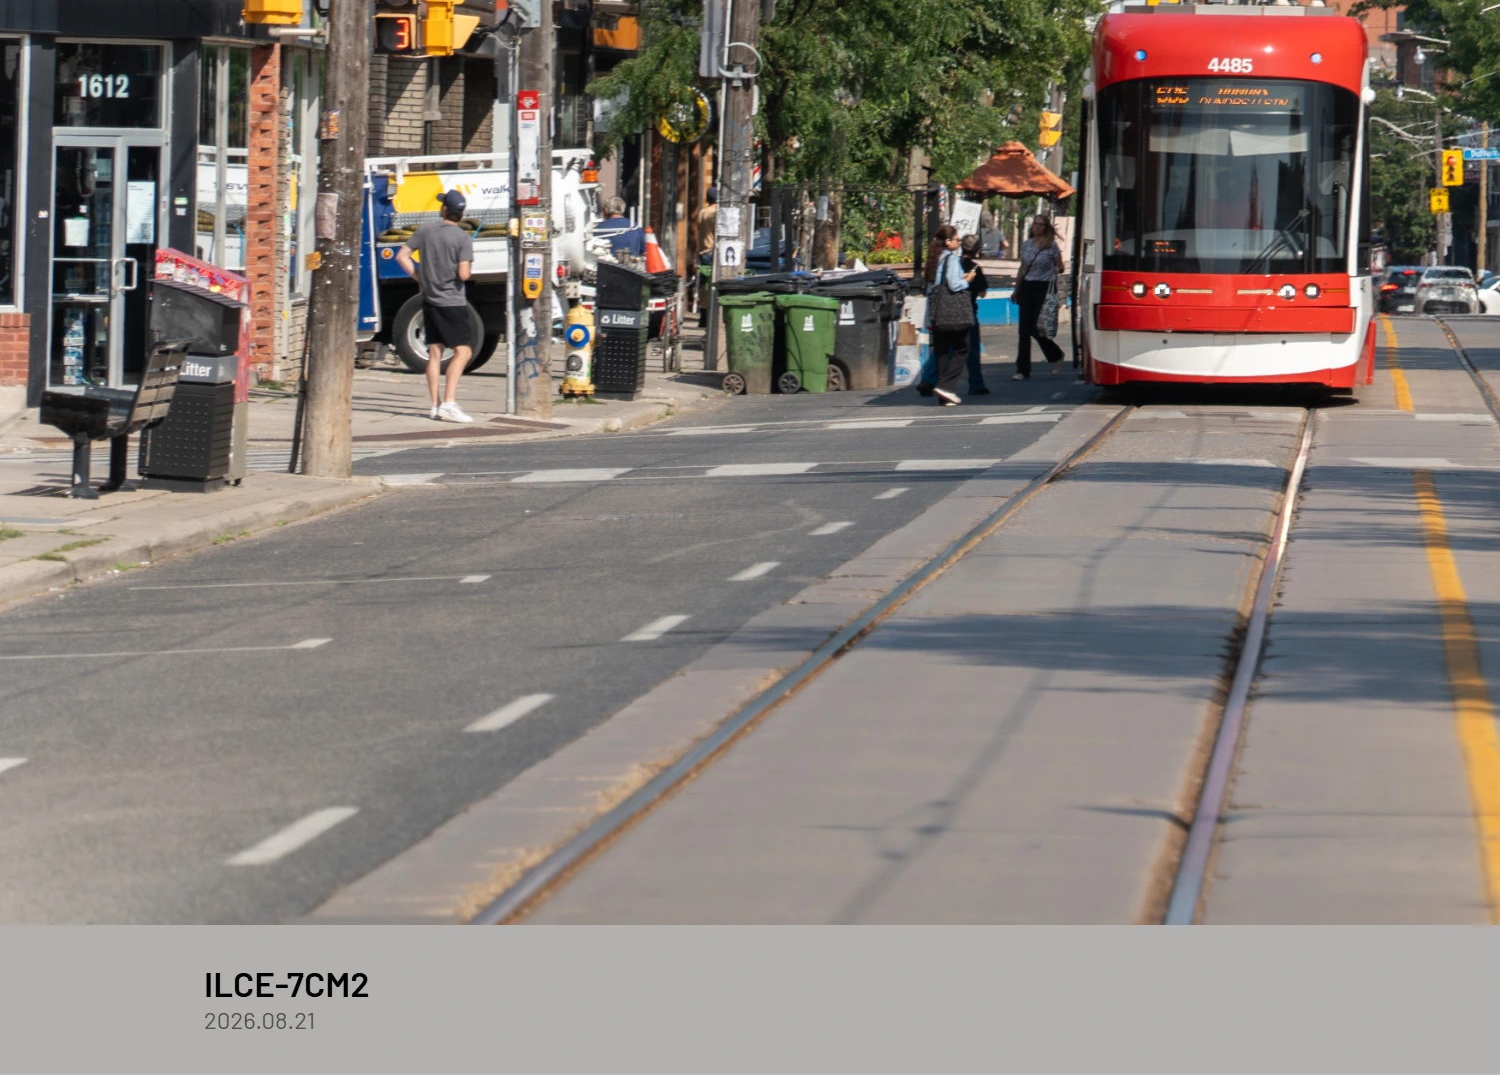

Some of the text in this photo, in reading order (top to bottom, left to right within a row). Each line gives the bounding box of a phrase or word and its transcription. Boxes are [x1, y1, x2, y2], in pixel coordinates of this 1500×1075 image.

[395, 18, 410, 50] 3
[1207, 57, 1254, 74] 4485
[78, 74, 130, 99] 1612
[611, 313, 636, 325] Litter
